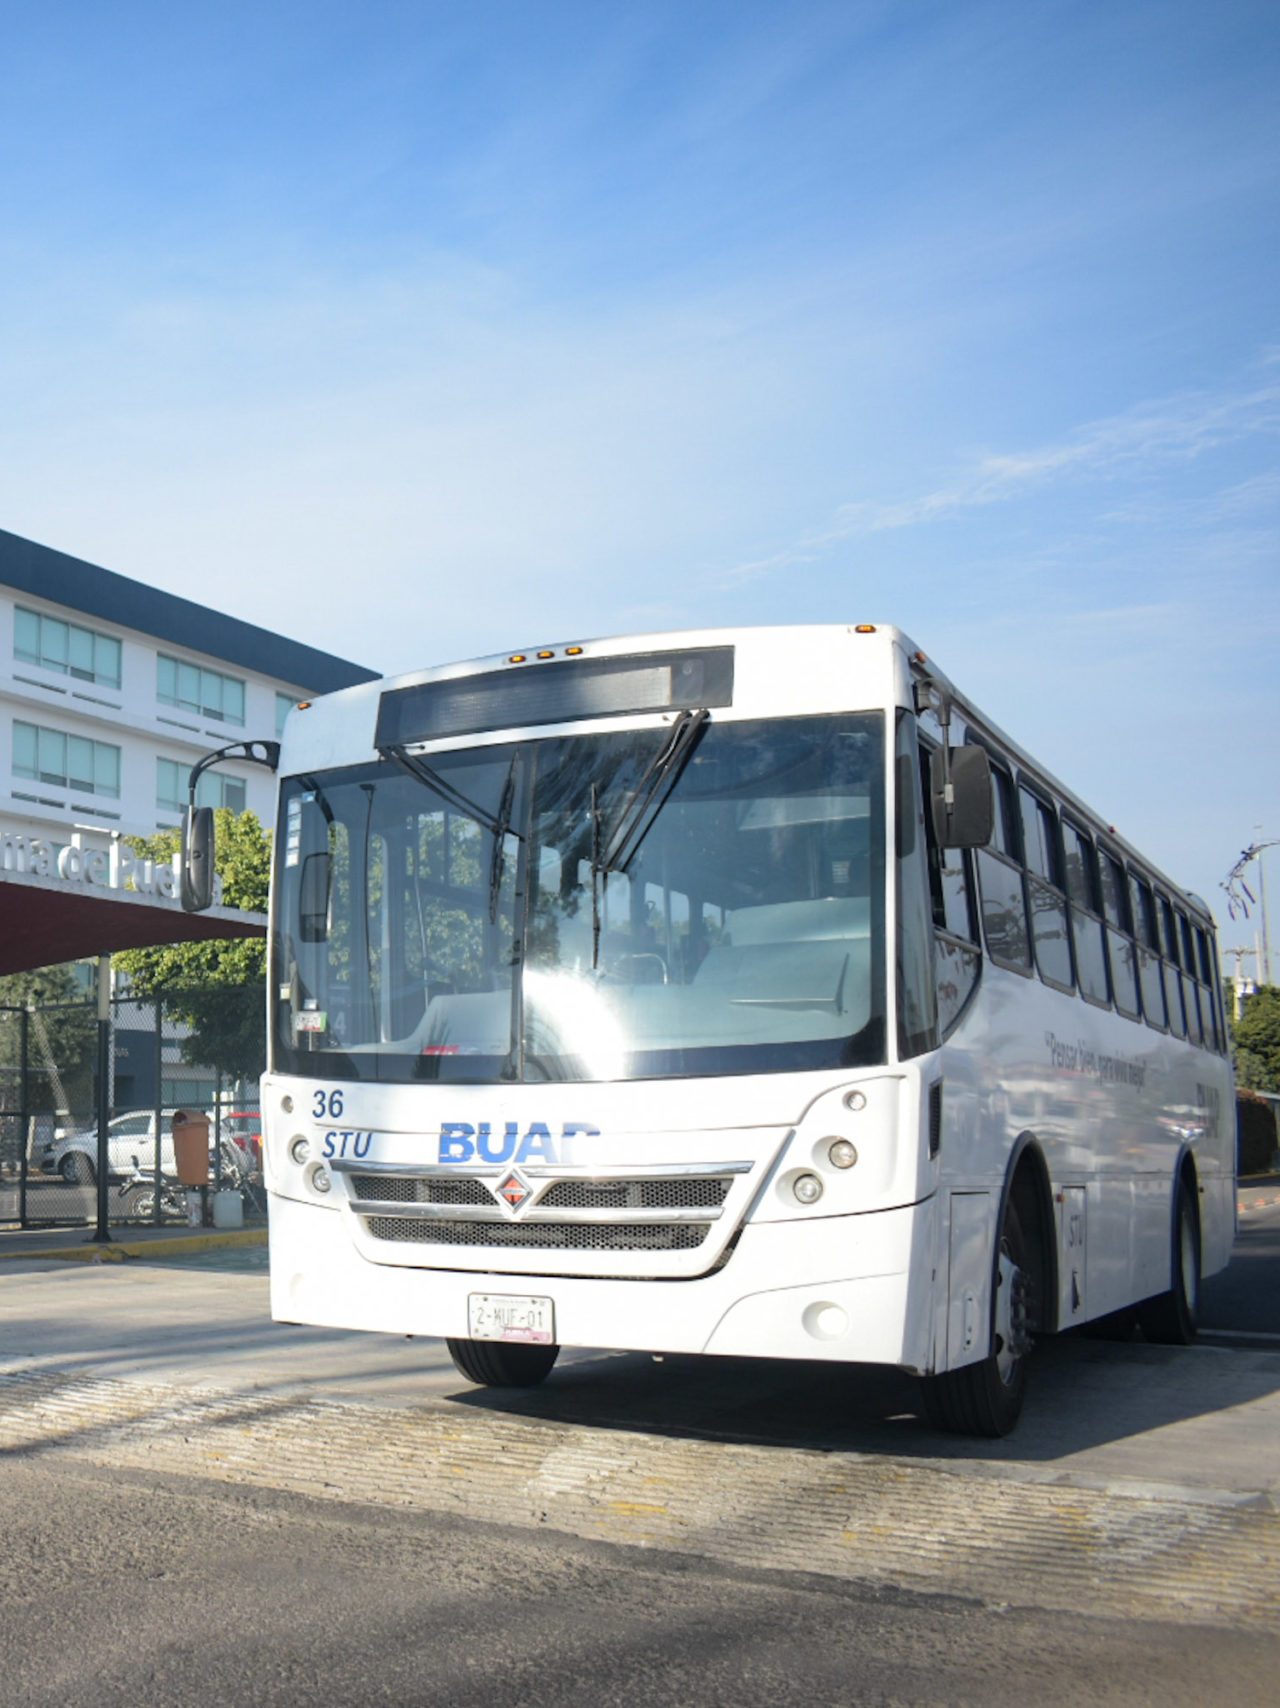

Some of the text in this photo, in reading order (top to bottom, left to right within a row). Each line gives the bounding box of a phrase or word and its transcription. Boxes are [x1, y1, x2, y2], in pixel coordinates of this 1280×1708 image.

[57, 833, 108, 886] de
[312, 1089, 344, 1119] 36
[322, 1131, 372, 1158] STU
